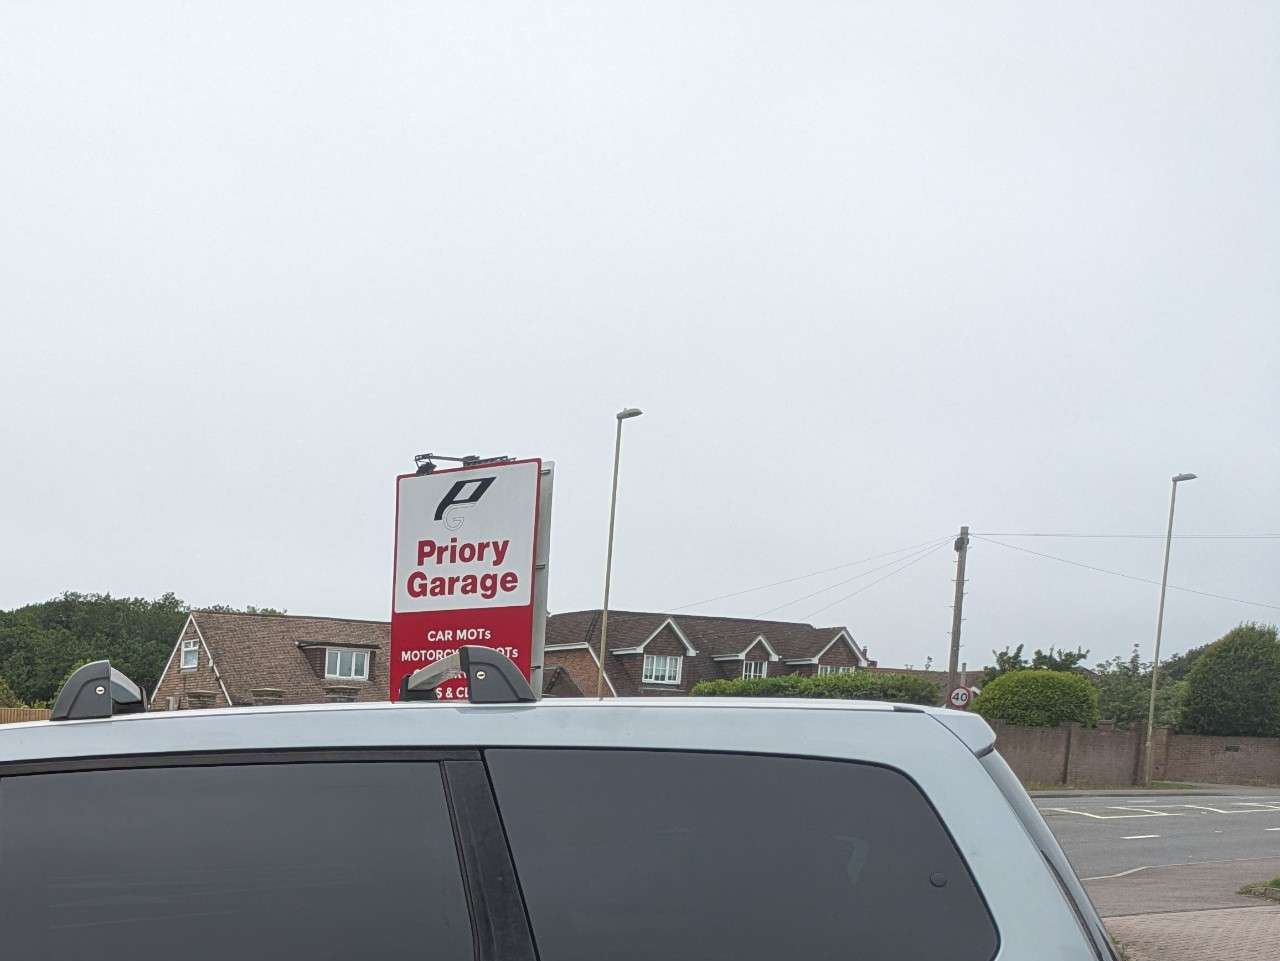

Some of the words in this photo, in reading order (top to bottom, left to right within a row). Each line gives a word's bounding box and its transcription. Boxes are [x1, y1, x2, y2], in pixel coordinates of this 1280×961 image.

[417, 538, 509, 566] Priory
[407, 571, 519, 599] Garage
[427, 630, 453, 642] CAR
[456, 628, 492, 641] MOTs
[952, 692, 967, 702] 40
